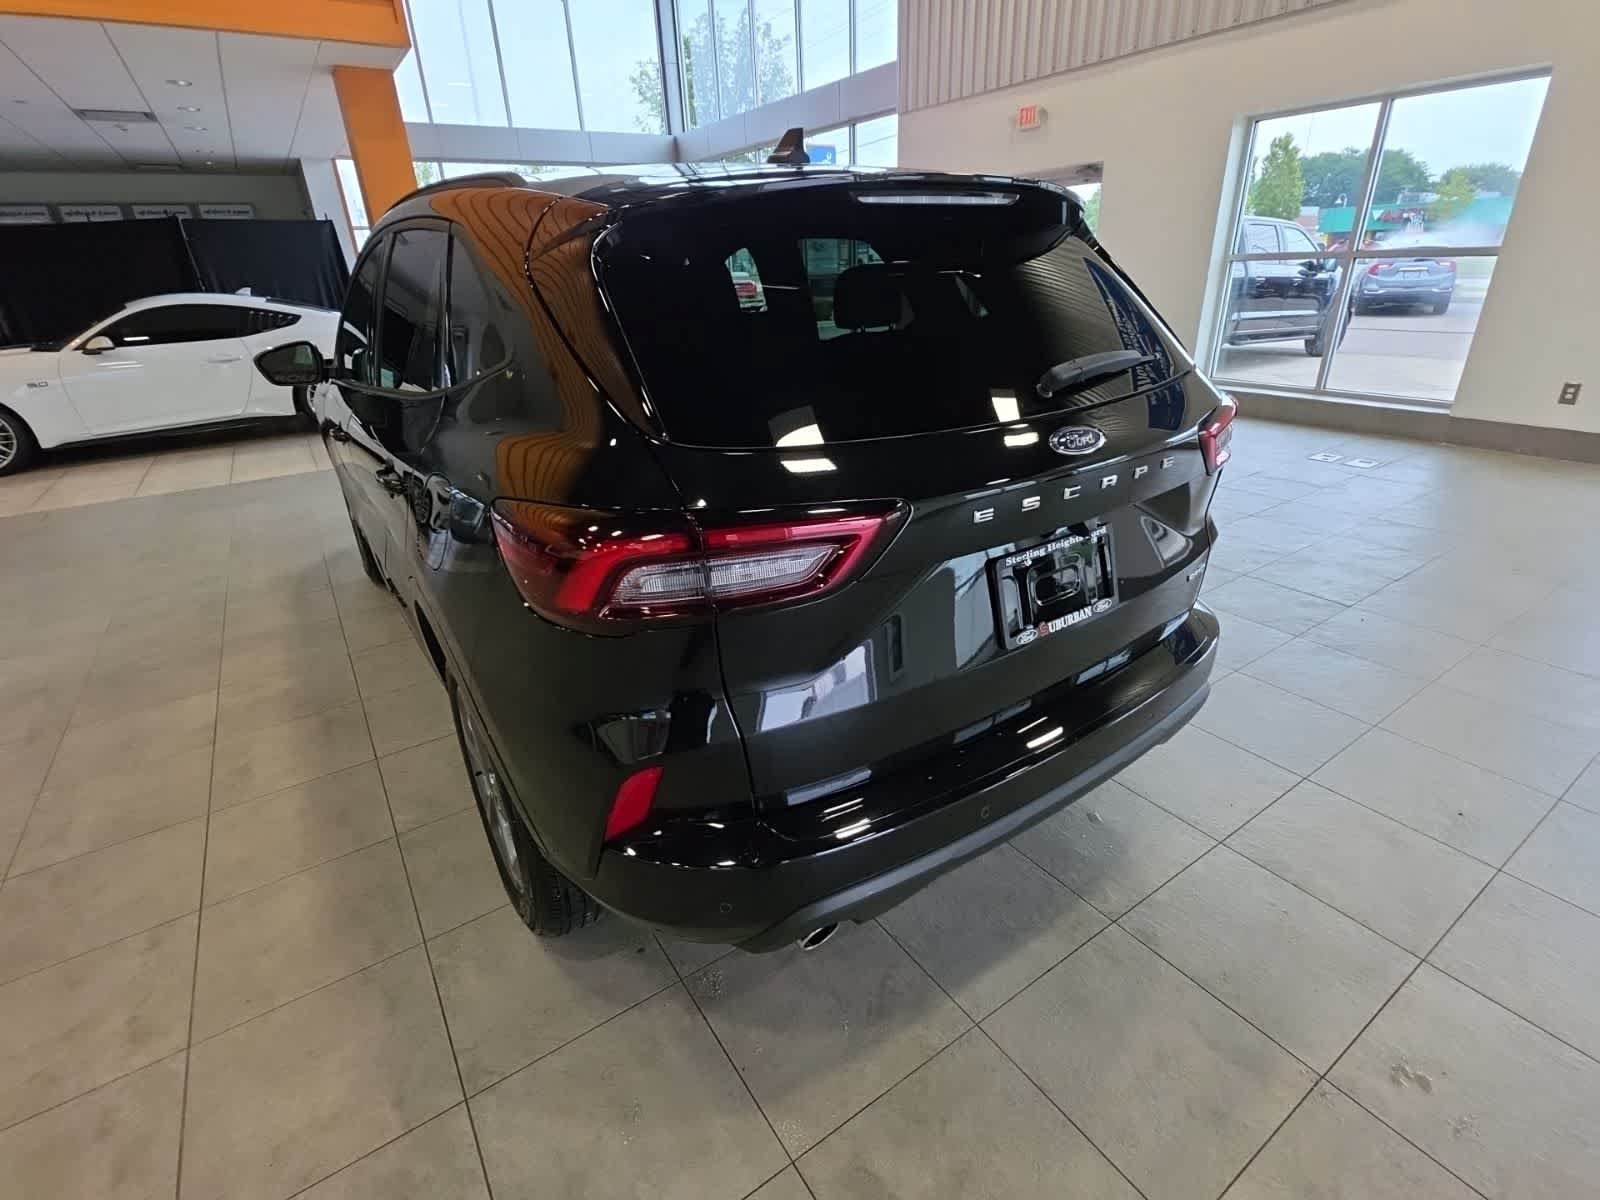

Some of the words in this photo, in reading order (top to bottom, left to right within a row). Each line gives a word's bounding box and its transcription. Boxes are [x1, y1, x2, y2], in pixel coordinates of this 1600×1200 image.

[1055, 429, 1099, 450] Ford
[973, 456, 1176, 524] ESCAPE
[1005, 547, 1047, 567] Sterling
[1047, 536, 1083, 553] Heights
[1038, 606, 1092, 637] SUBURBAN
